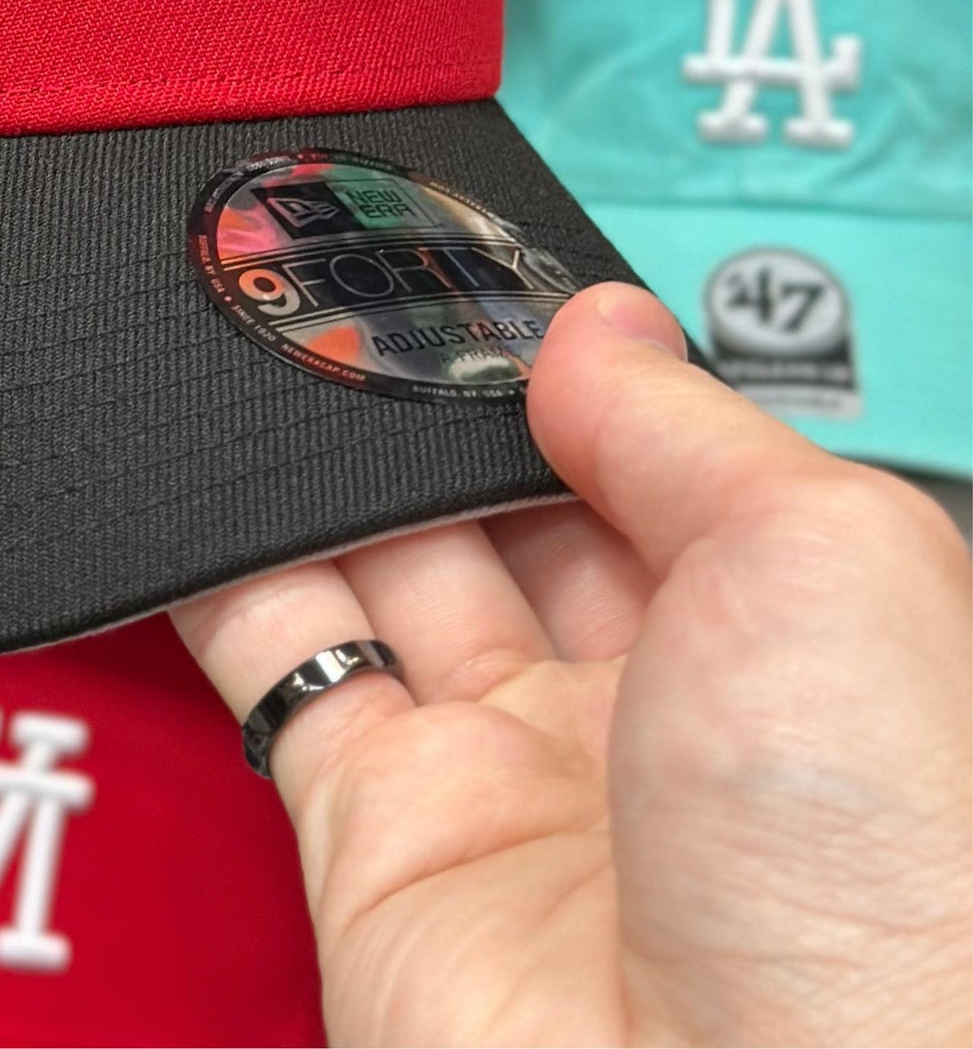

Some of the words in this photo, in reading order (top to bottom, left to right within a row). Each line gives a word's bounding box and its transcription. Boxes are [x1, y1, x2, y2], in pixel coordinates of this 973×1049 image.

[345, 189, 403, 204] NEW
[361, 204, 416, 219] ERA
[238, 246, 534, 316] 9FORTY
[231, 304, 256, 326] SINCE
[254, 323, 276, 342] 1920
[371, 320, 544, 356] ADJUSTABLE
